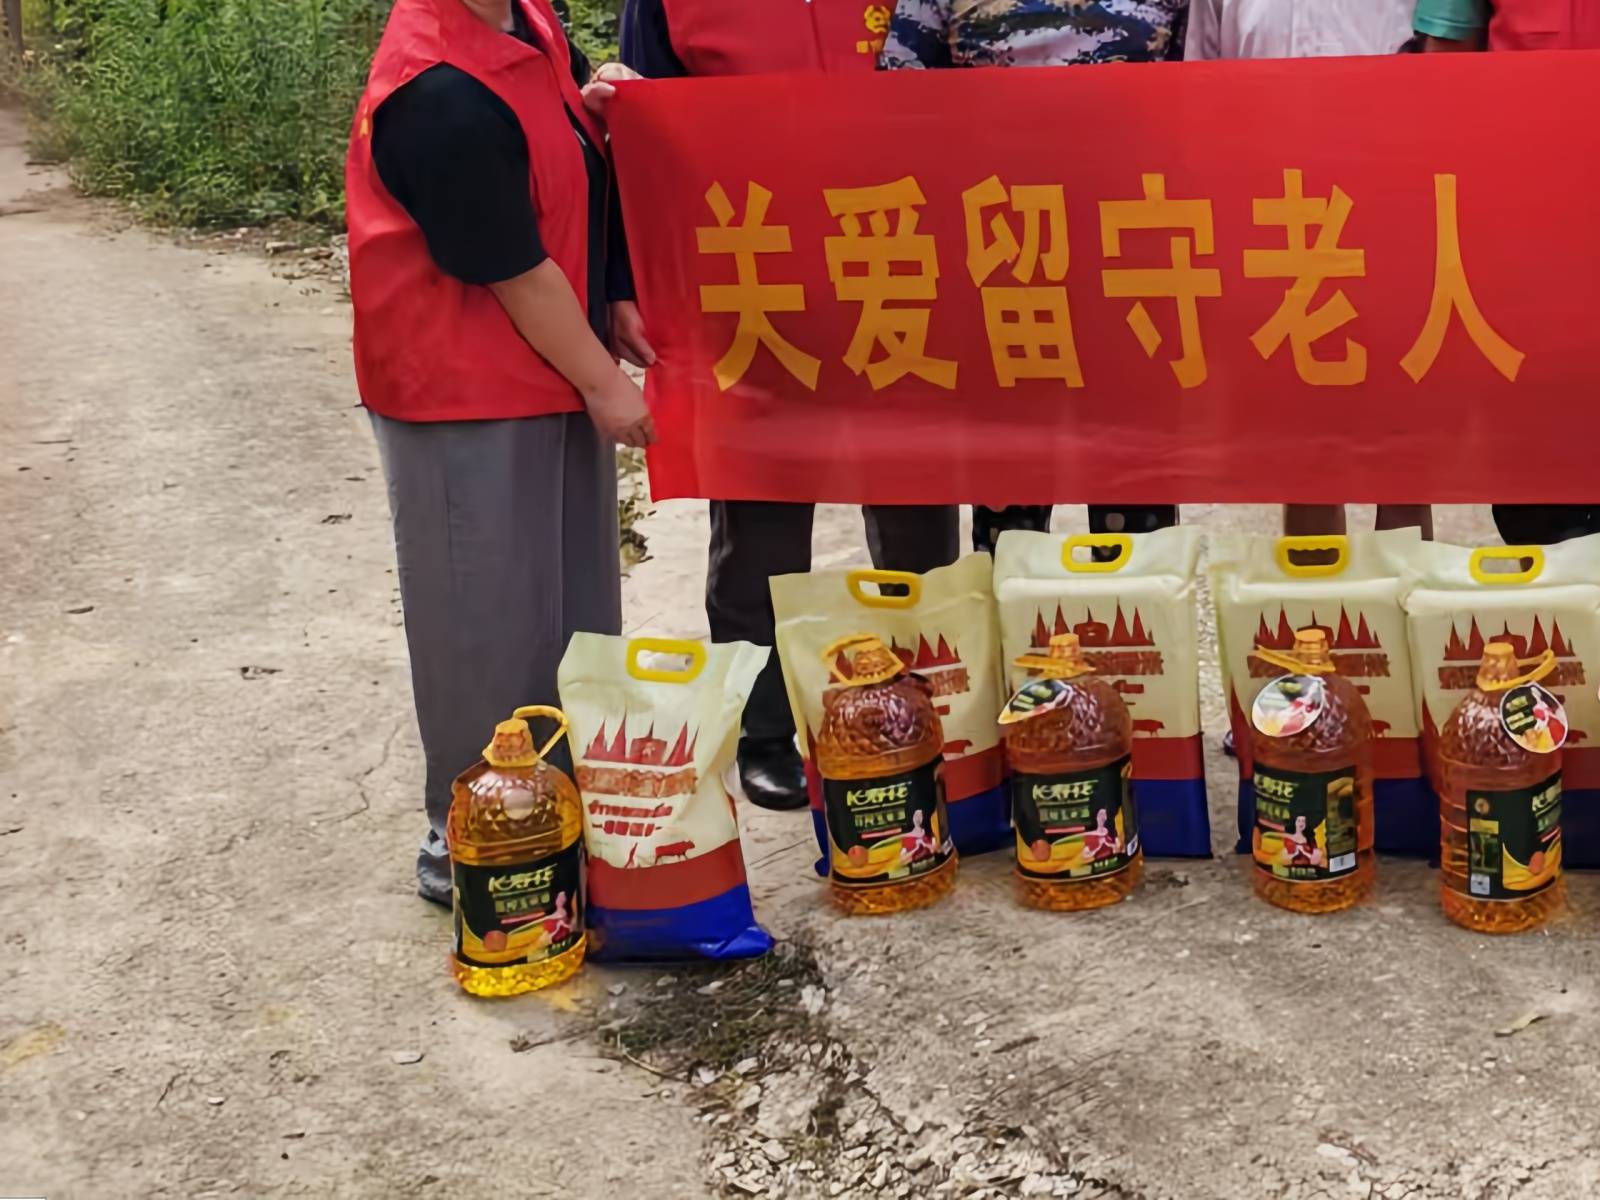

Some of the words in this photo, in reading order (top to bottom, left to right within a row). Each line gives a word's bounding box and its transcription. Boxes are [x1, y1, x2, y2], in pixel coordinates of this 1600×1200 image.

[695, 167, 1526, 391] 关爱留守老人
